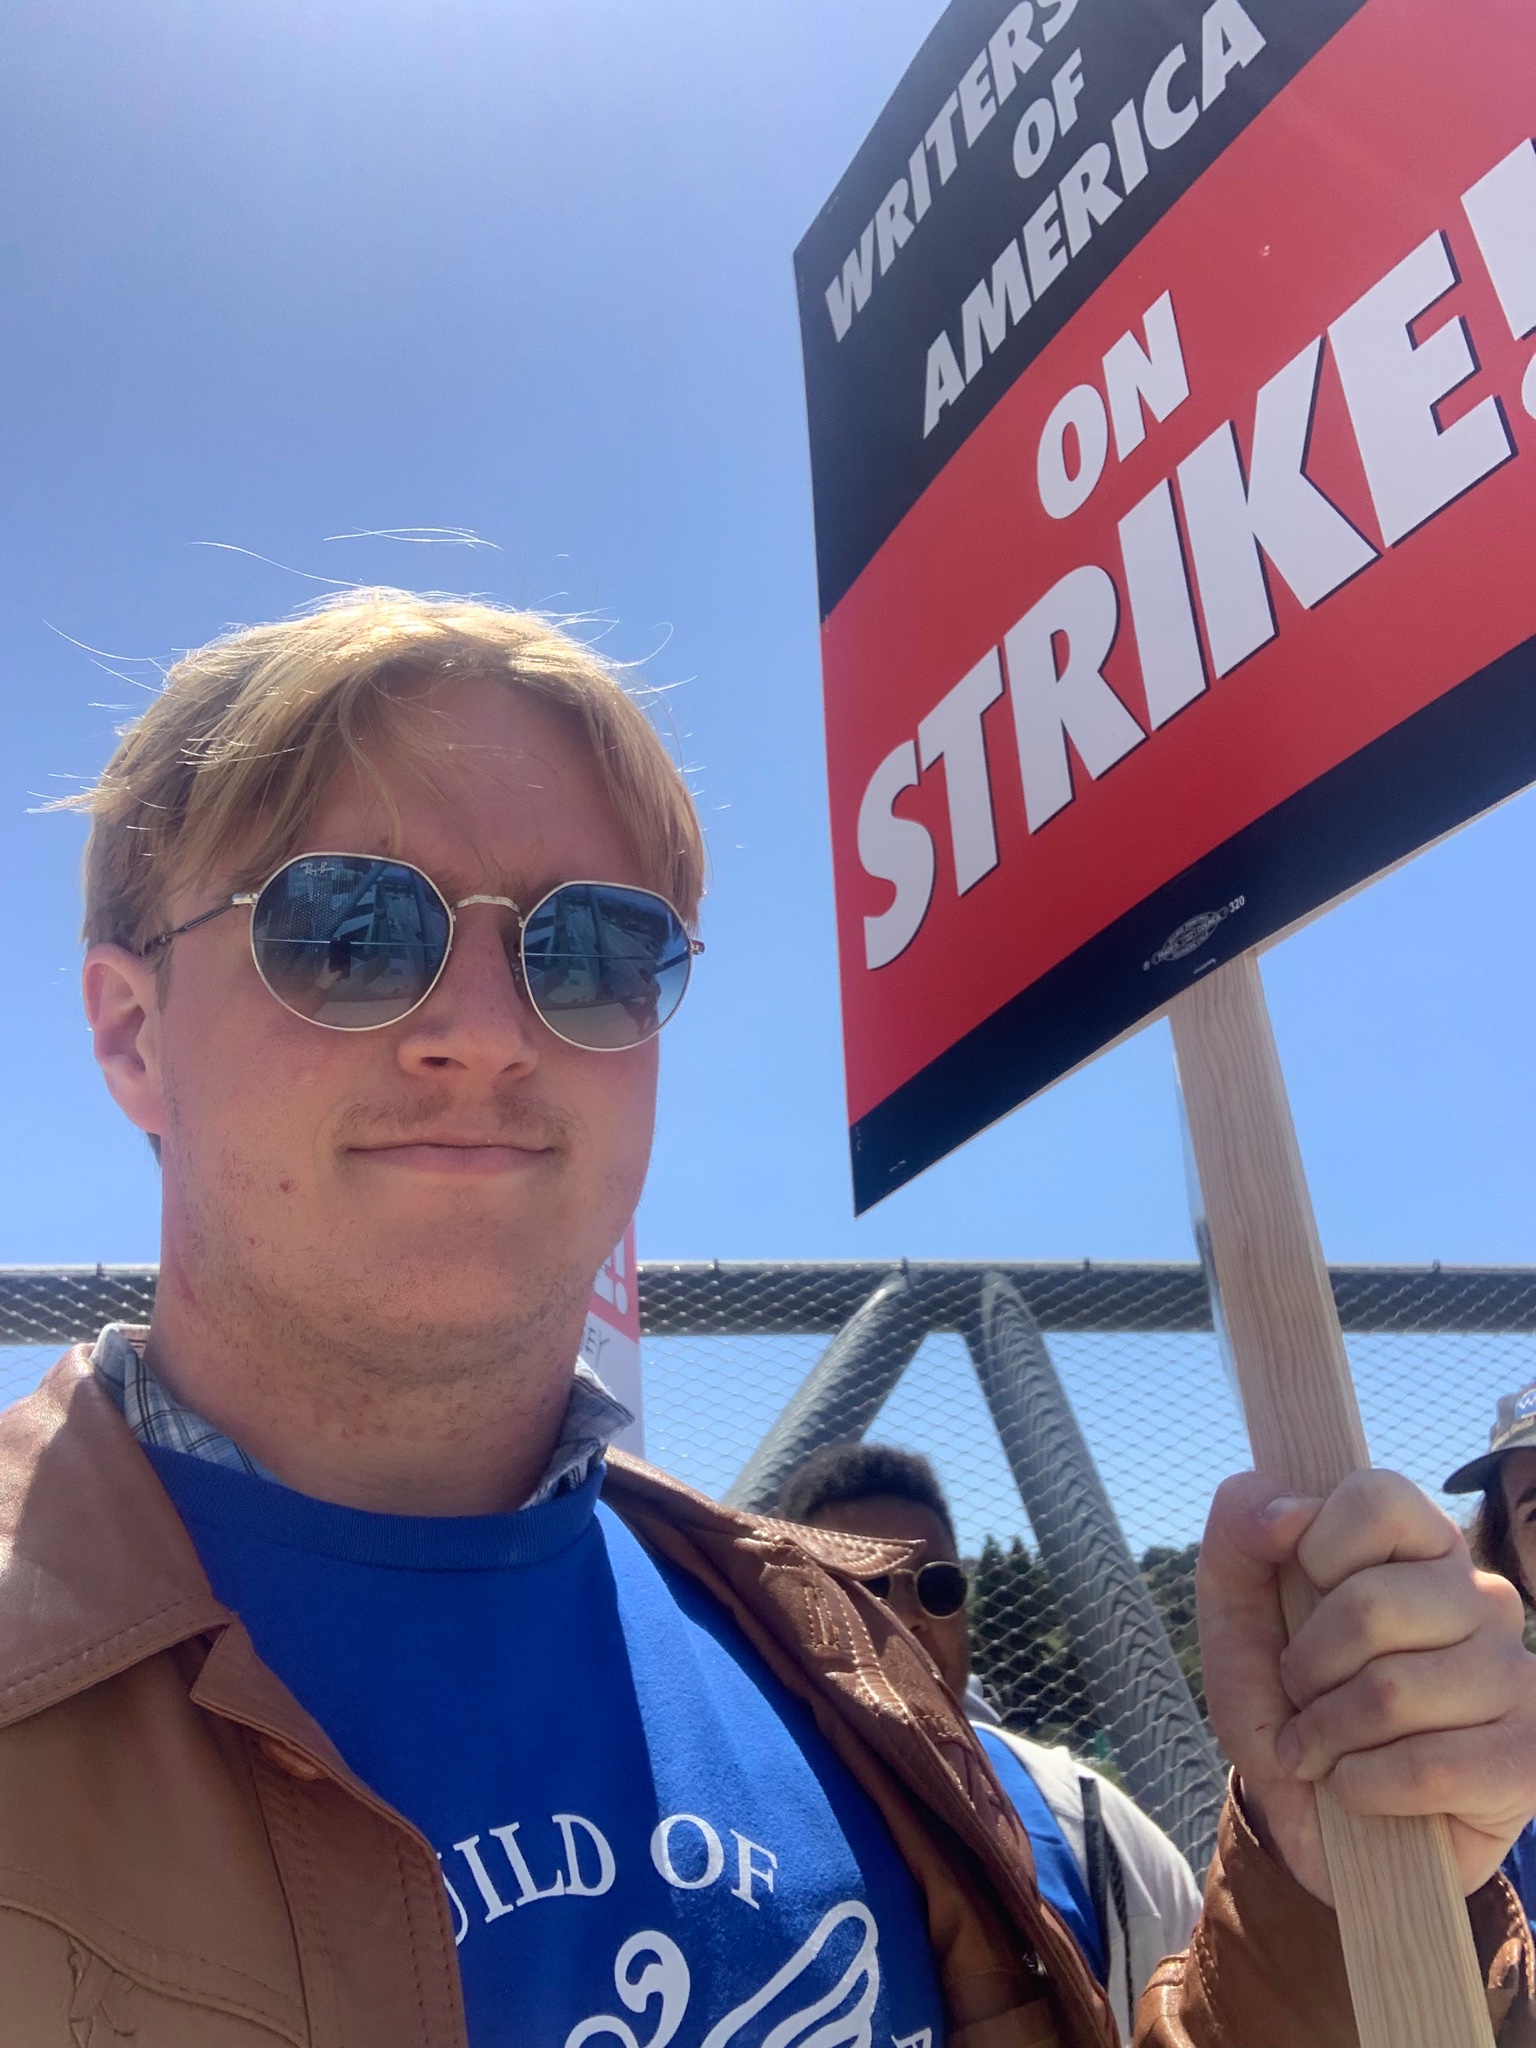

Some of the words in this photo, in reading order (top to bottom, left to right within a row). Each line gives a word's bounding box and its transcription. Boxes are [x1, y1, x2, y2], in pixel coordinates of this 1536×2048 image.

[1013, 49, 1085, 179] OF
[924, 0, 1266, 439] AMERICA
[1037, 290, 1190, 519] ON
[1229, 895, 1245, 912] 320
[650, 1814, 778, 1909] OF
